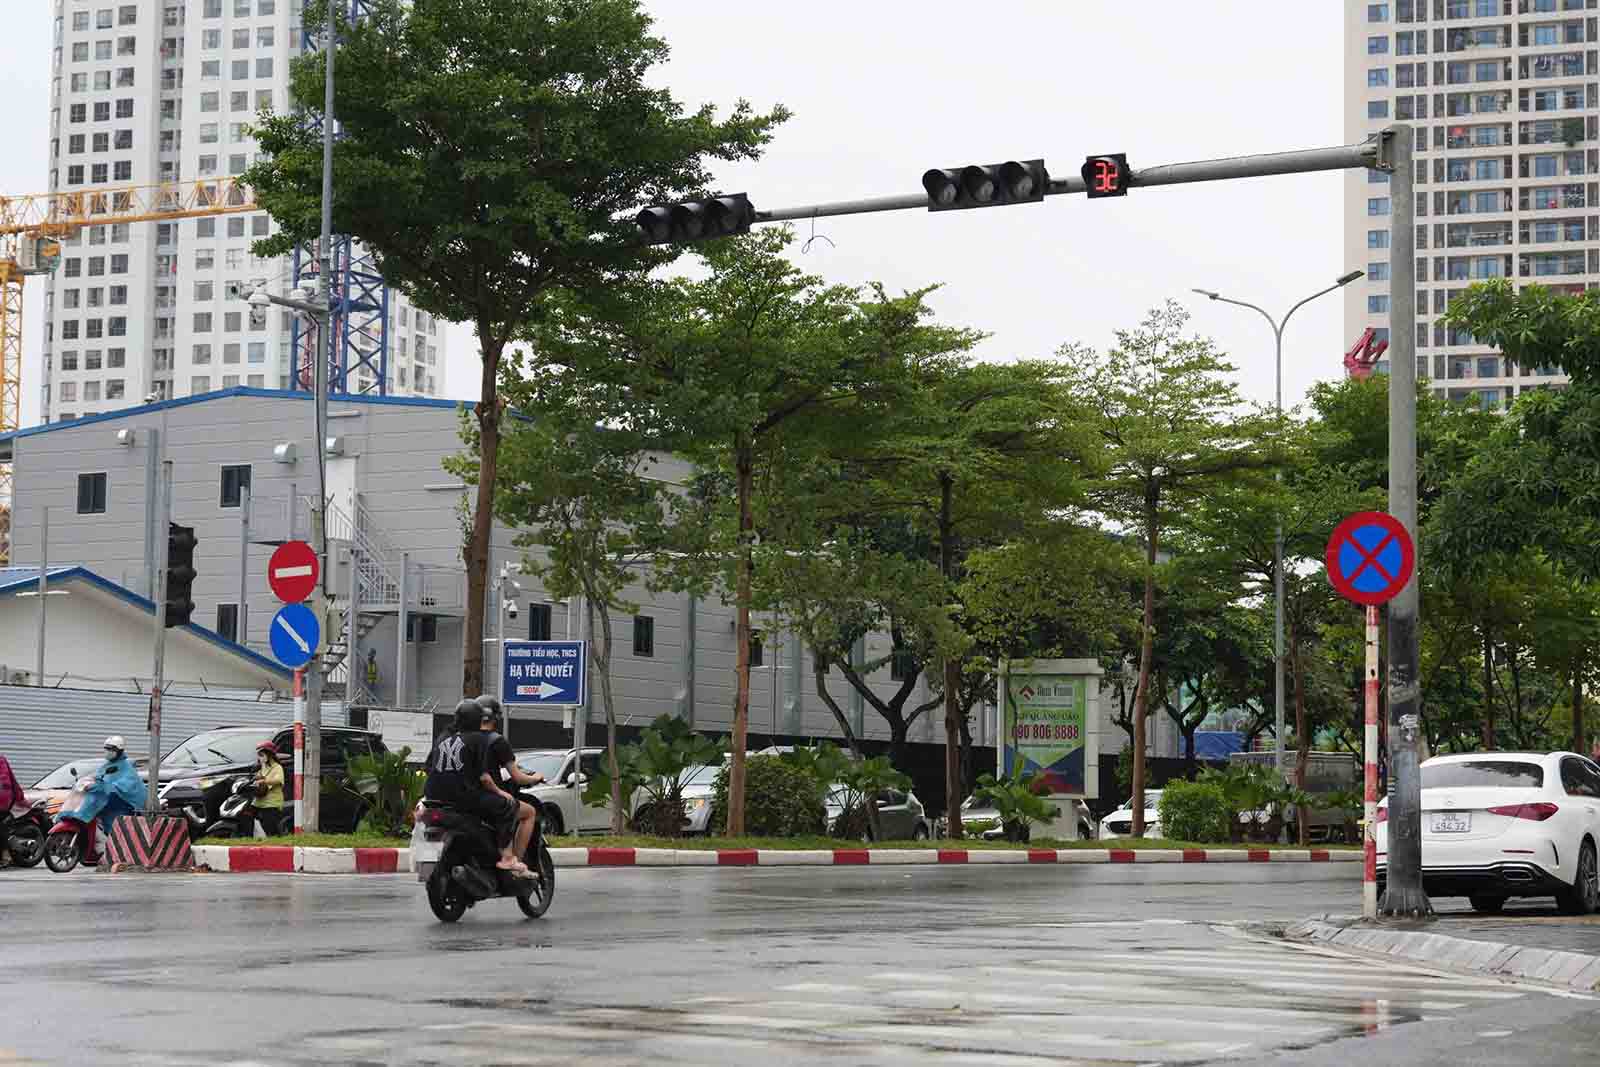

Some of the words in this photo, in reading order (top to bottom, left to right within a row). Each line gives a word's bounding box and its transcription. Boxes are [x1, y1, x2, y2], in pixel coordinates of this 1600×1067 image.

[1096, 162, 1118, 191] 32
[562, 649, 577, 657] THCS
[510, 664, 523, 679] HẠ
[525, 662, 543, 678] YÊN
[545, 661, 573, 678] QUYẾT
[1033, 724, 1052, 739] 806
[1055, 724, 1079, 740] 8888
[435, 736, 465, 772] NY
